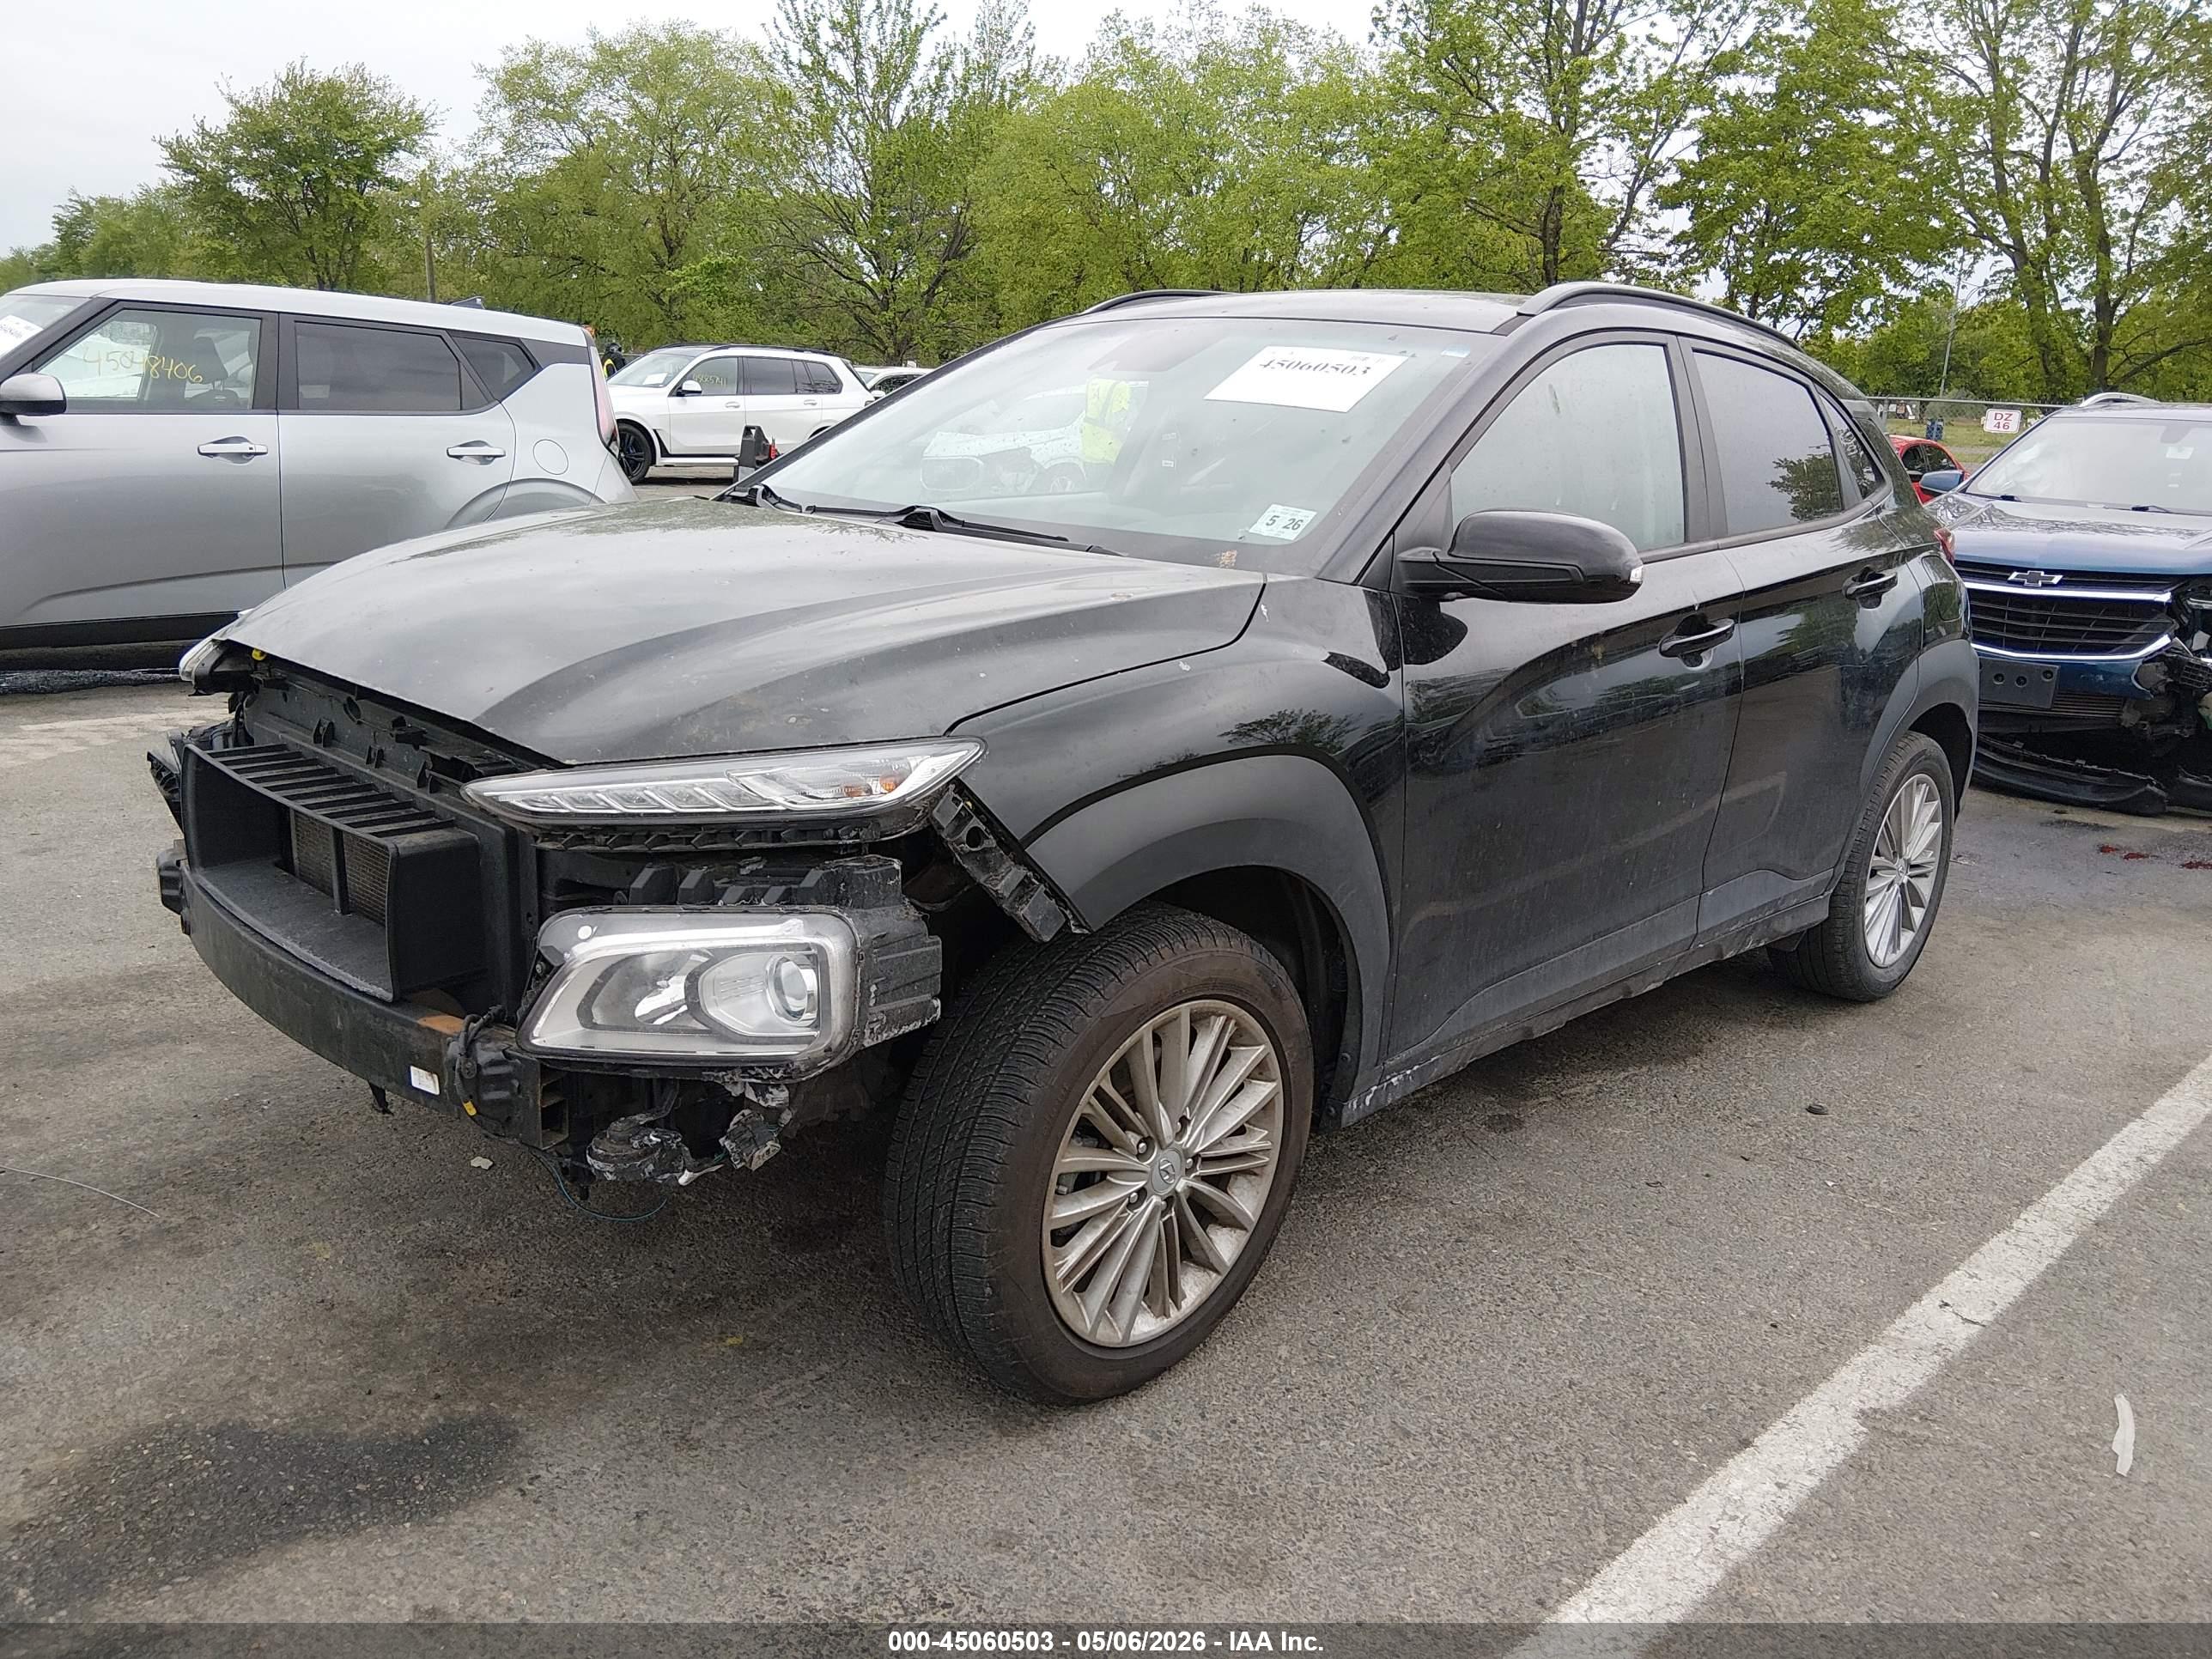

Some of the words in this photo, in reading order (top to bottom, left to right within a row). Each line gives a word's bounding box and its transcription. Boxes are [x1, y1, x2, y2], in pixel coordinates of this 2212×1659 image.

[1259, 359, 1371, 376] 45060503
[1994, 412, 2014, 422] DZ
[1993, 421, 2011, 430] 46
[1265, 514, 1280, 526] 5
[1282, 518, 1304, 531] 26
